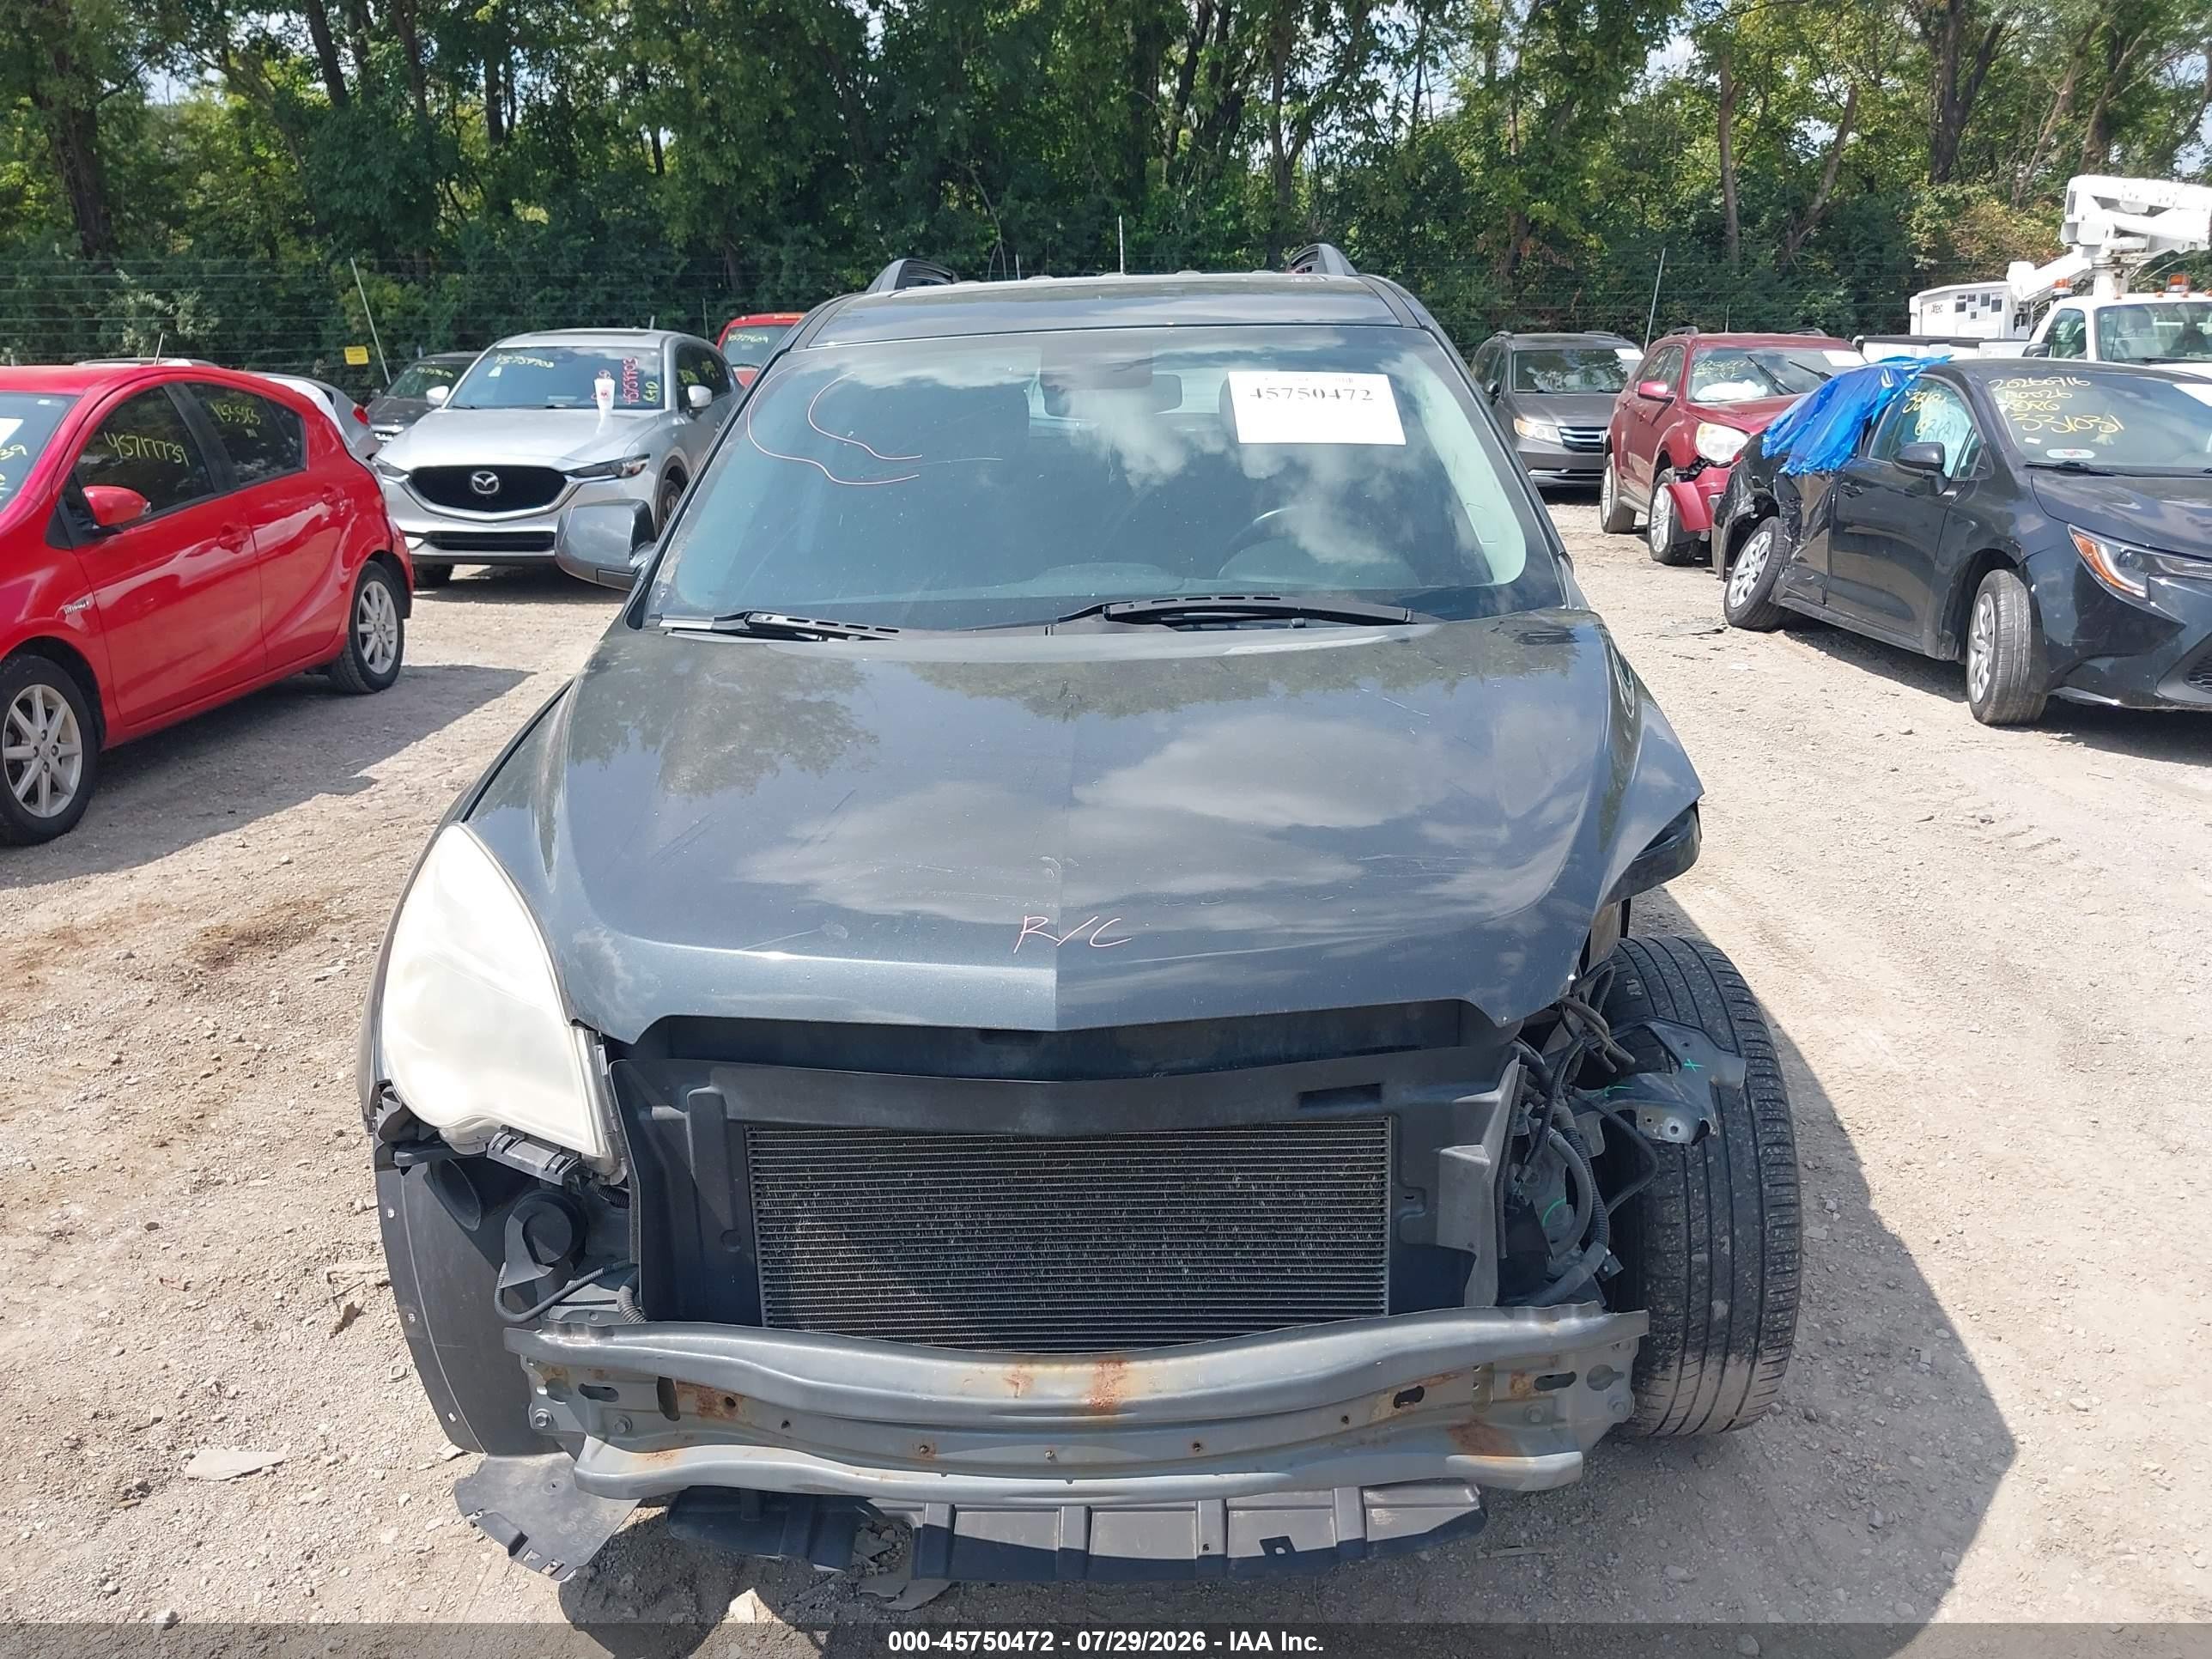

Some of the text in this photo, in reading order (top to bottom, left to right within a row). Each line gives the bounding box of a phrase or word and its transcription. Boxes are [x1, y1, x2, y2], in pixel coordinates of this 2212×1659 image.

[1988, 376, 2092, 392] 20260716
[1249, 387, 1374, 401] 45750472
[2010, 413, 2125, 434] 331031
[104, 431, 191, 467] 45717739
